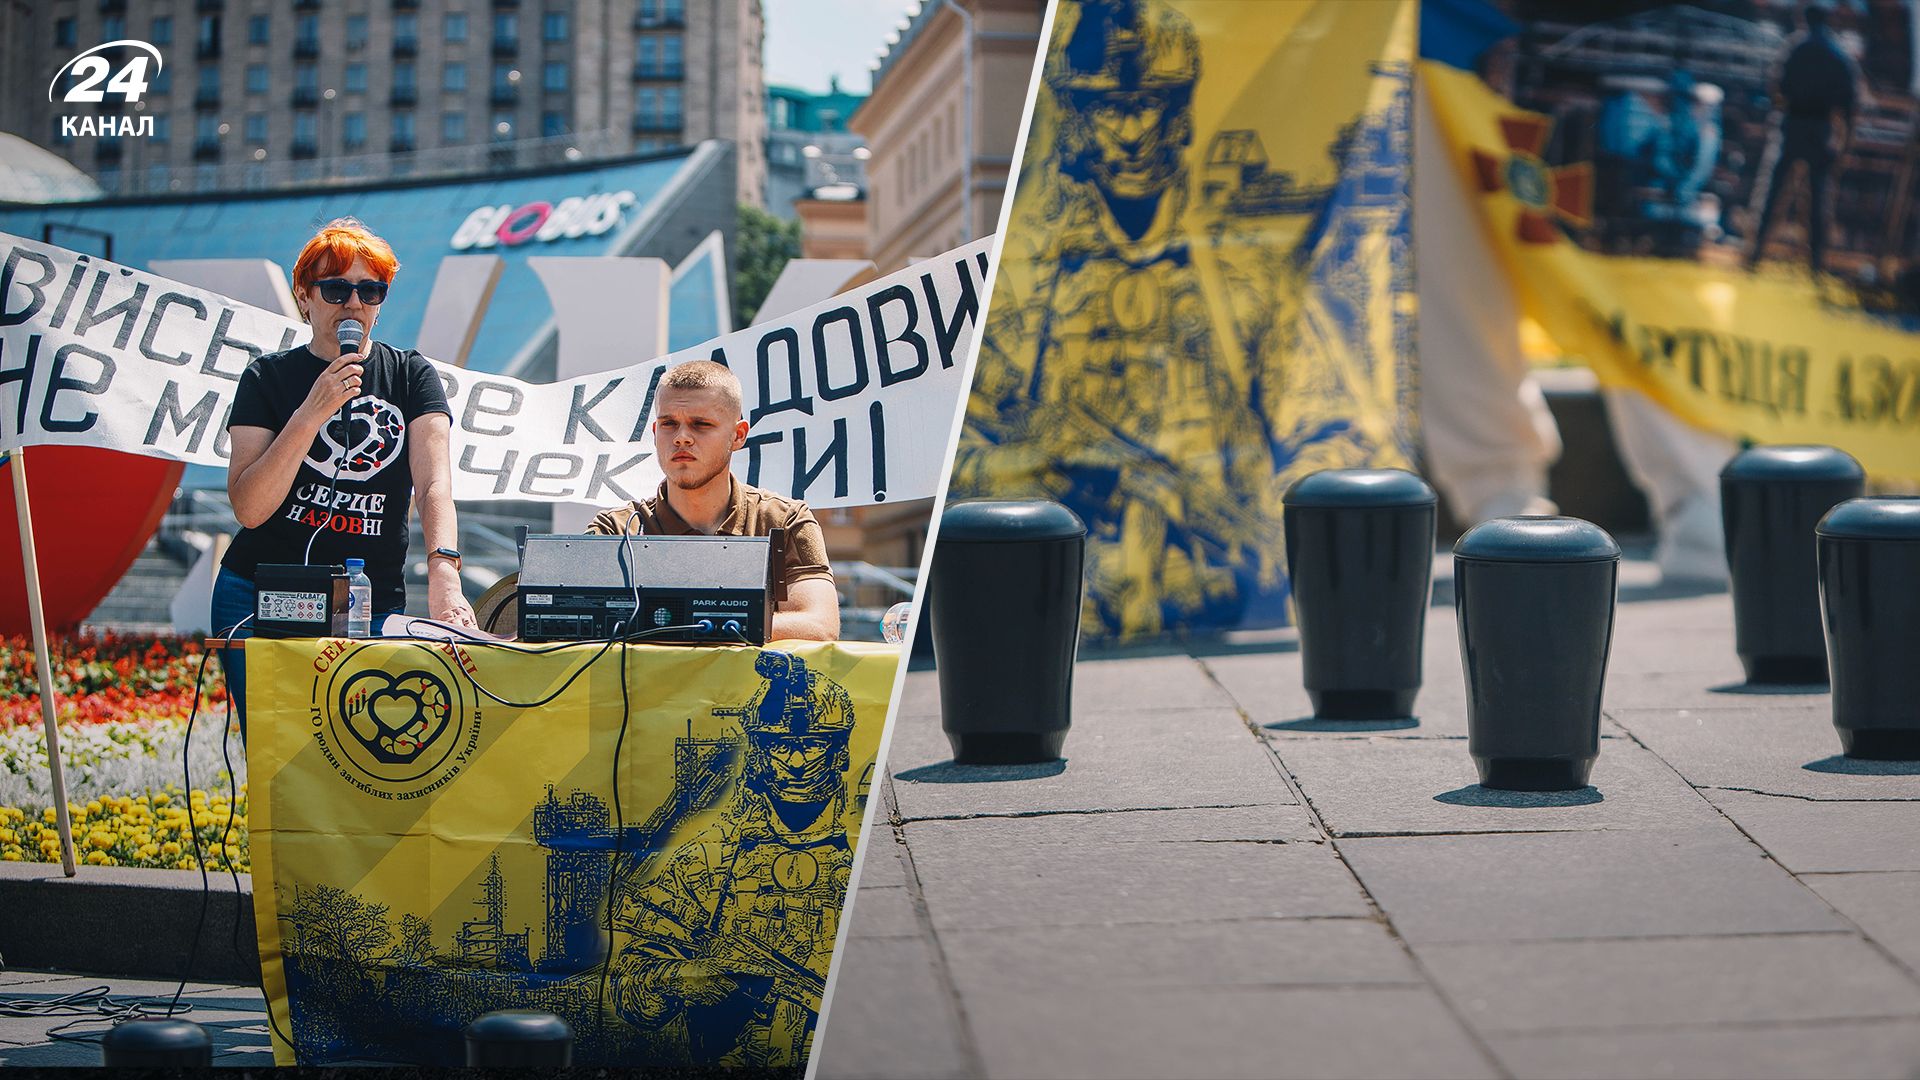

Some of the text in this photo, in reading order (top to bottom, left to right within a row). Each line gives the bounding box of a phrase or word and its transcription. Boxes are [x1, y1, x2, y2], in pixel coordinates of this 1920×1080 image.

[450, 190, 637, 249] GLOBUS
[286, 504, 383, 536] НАЗОВНІ
[296, 483, 386, 518] СЕРЦЕ
[310, 706, 482, 801] ГО родин загиблих захисників України
